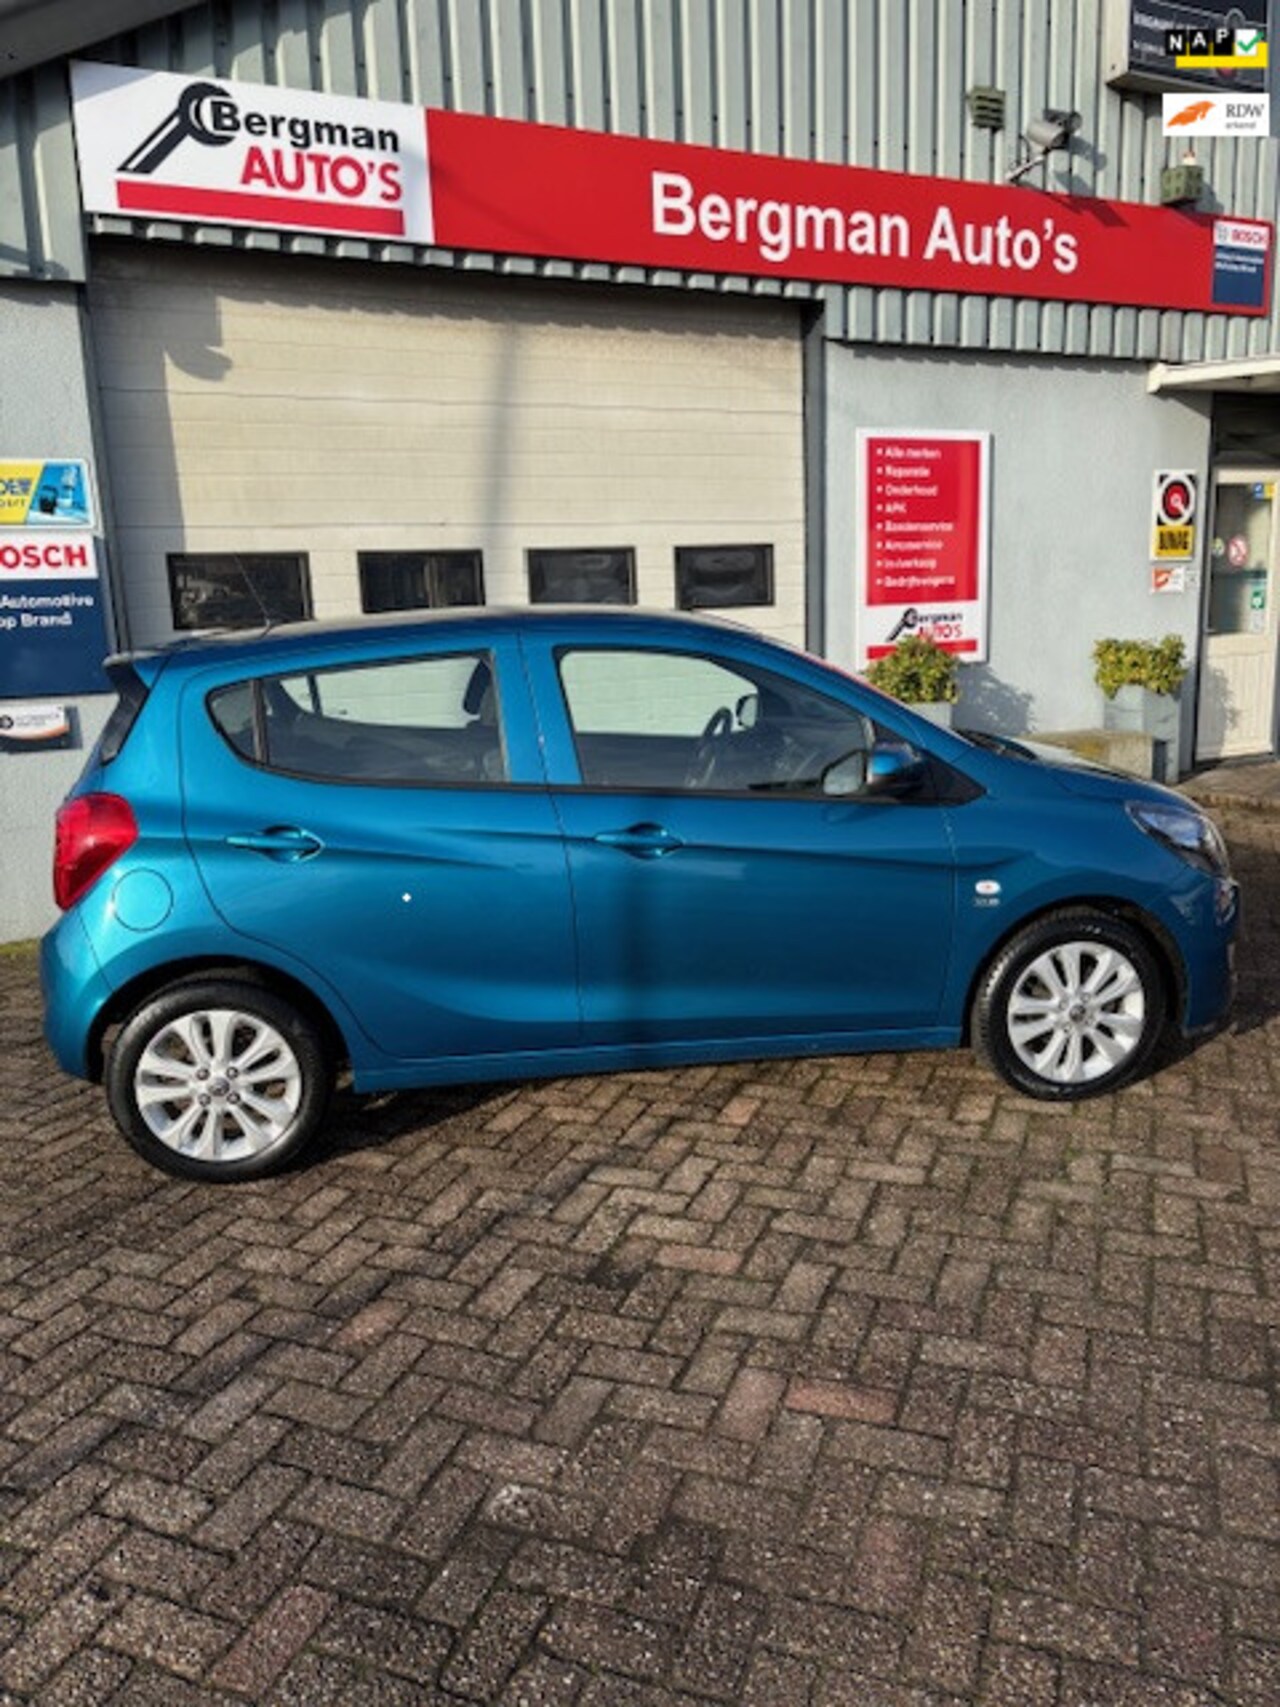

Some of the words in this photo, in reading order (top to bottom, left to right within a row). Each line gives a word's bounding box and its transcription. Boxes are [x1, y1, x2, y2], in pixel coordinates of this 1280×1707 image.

[210, 99, 399, 153] Bergman
[241, 145, 403, 201] AUTO'S
[651, 171, 909, 263] Bergman
[0, 545, 87, 568] OSCH
[0, 593, 94, 609] Automotive
[21, 612, 72, 628] Brand
